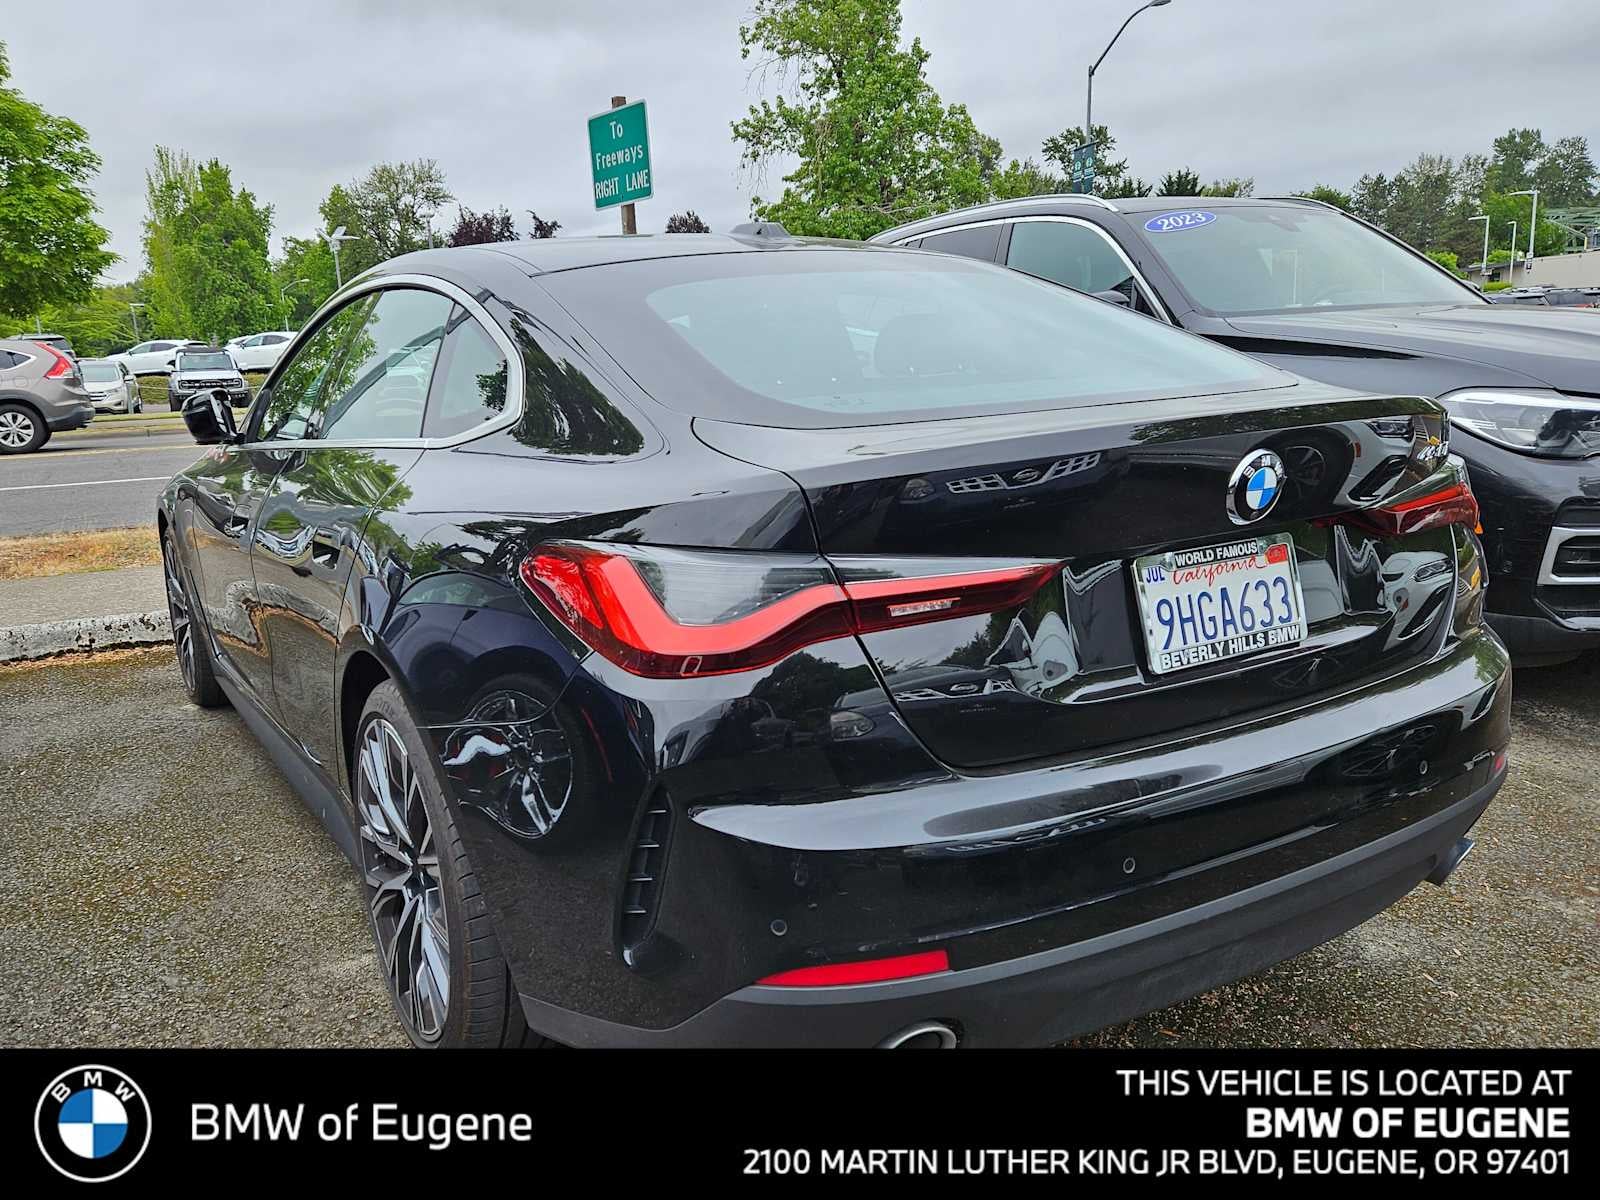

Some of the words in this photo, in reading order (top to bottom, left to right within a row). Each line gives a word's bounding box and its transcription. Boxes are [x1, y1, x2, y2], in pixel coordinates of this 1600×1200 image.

[609, 121, 624, 140] To
[595, 144, 644, 171] Freeways
[595, 177, 619, 200] RIGHT
[625, 169, 650, 192] LANE
[1157, 212, 1207, 231] 2023
[1243, 455, 1284, 479] BMW
[1174, 549, 1215, 567] WORLD
[1216, 541, 1258, 560] FAMOUS
[1146, 566, 1166, 584] JUL
[1172, 555, 1266, 587] California
[1156, 576, 1293, 650] 9HGA633
[1161, 641, 1225, 670] BEVERLY
[1228, 632, 1266, 655] HILLS
[1268, 625, 1300, 645] BMW
